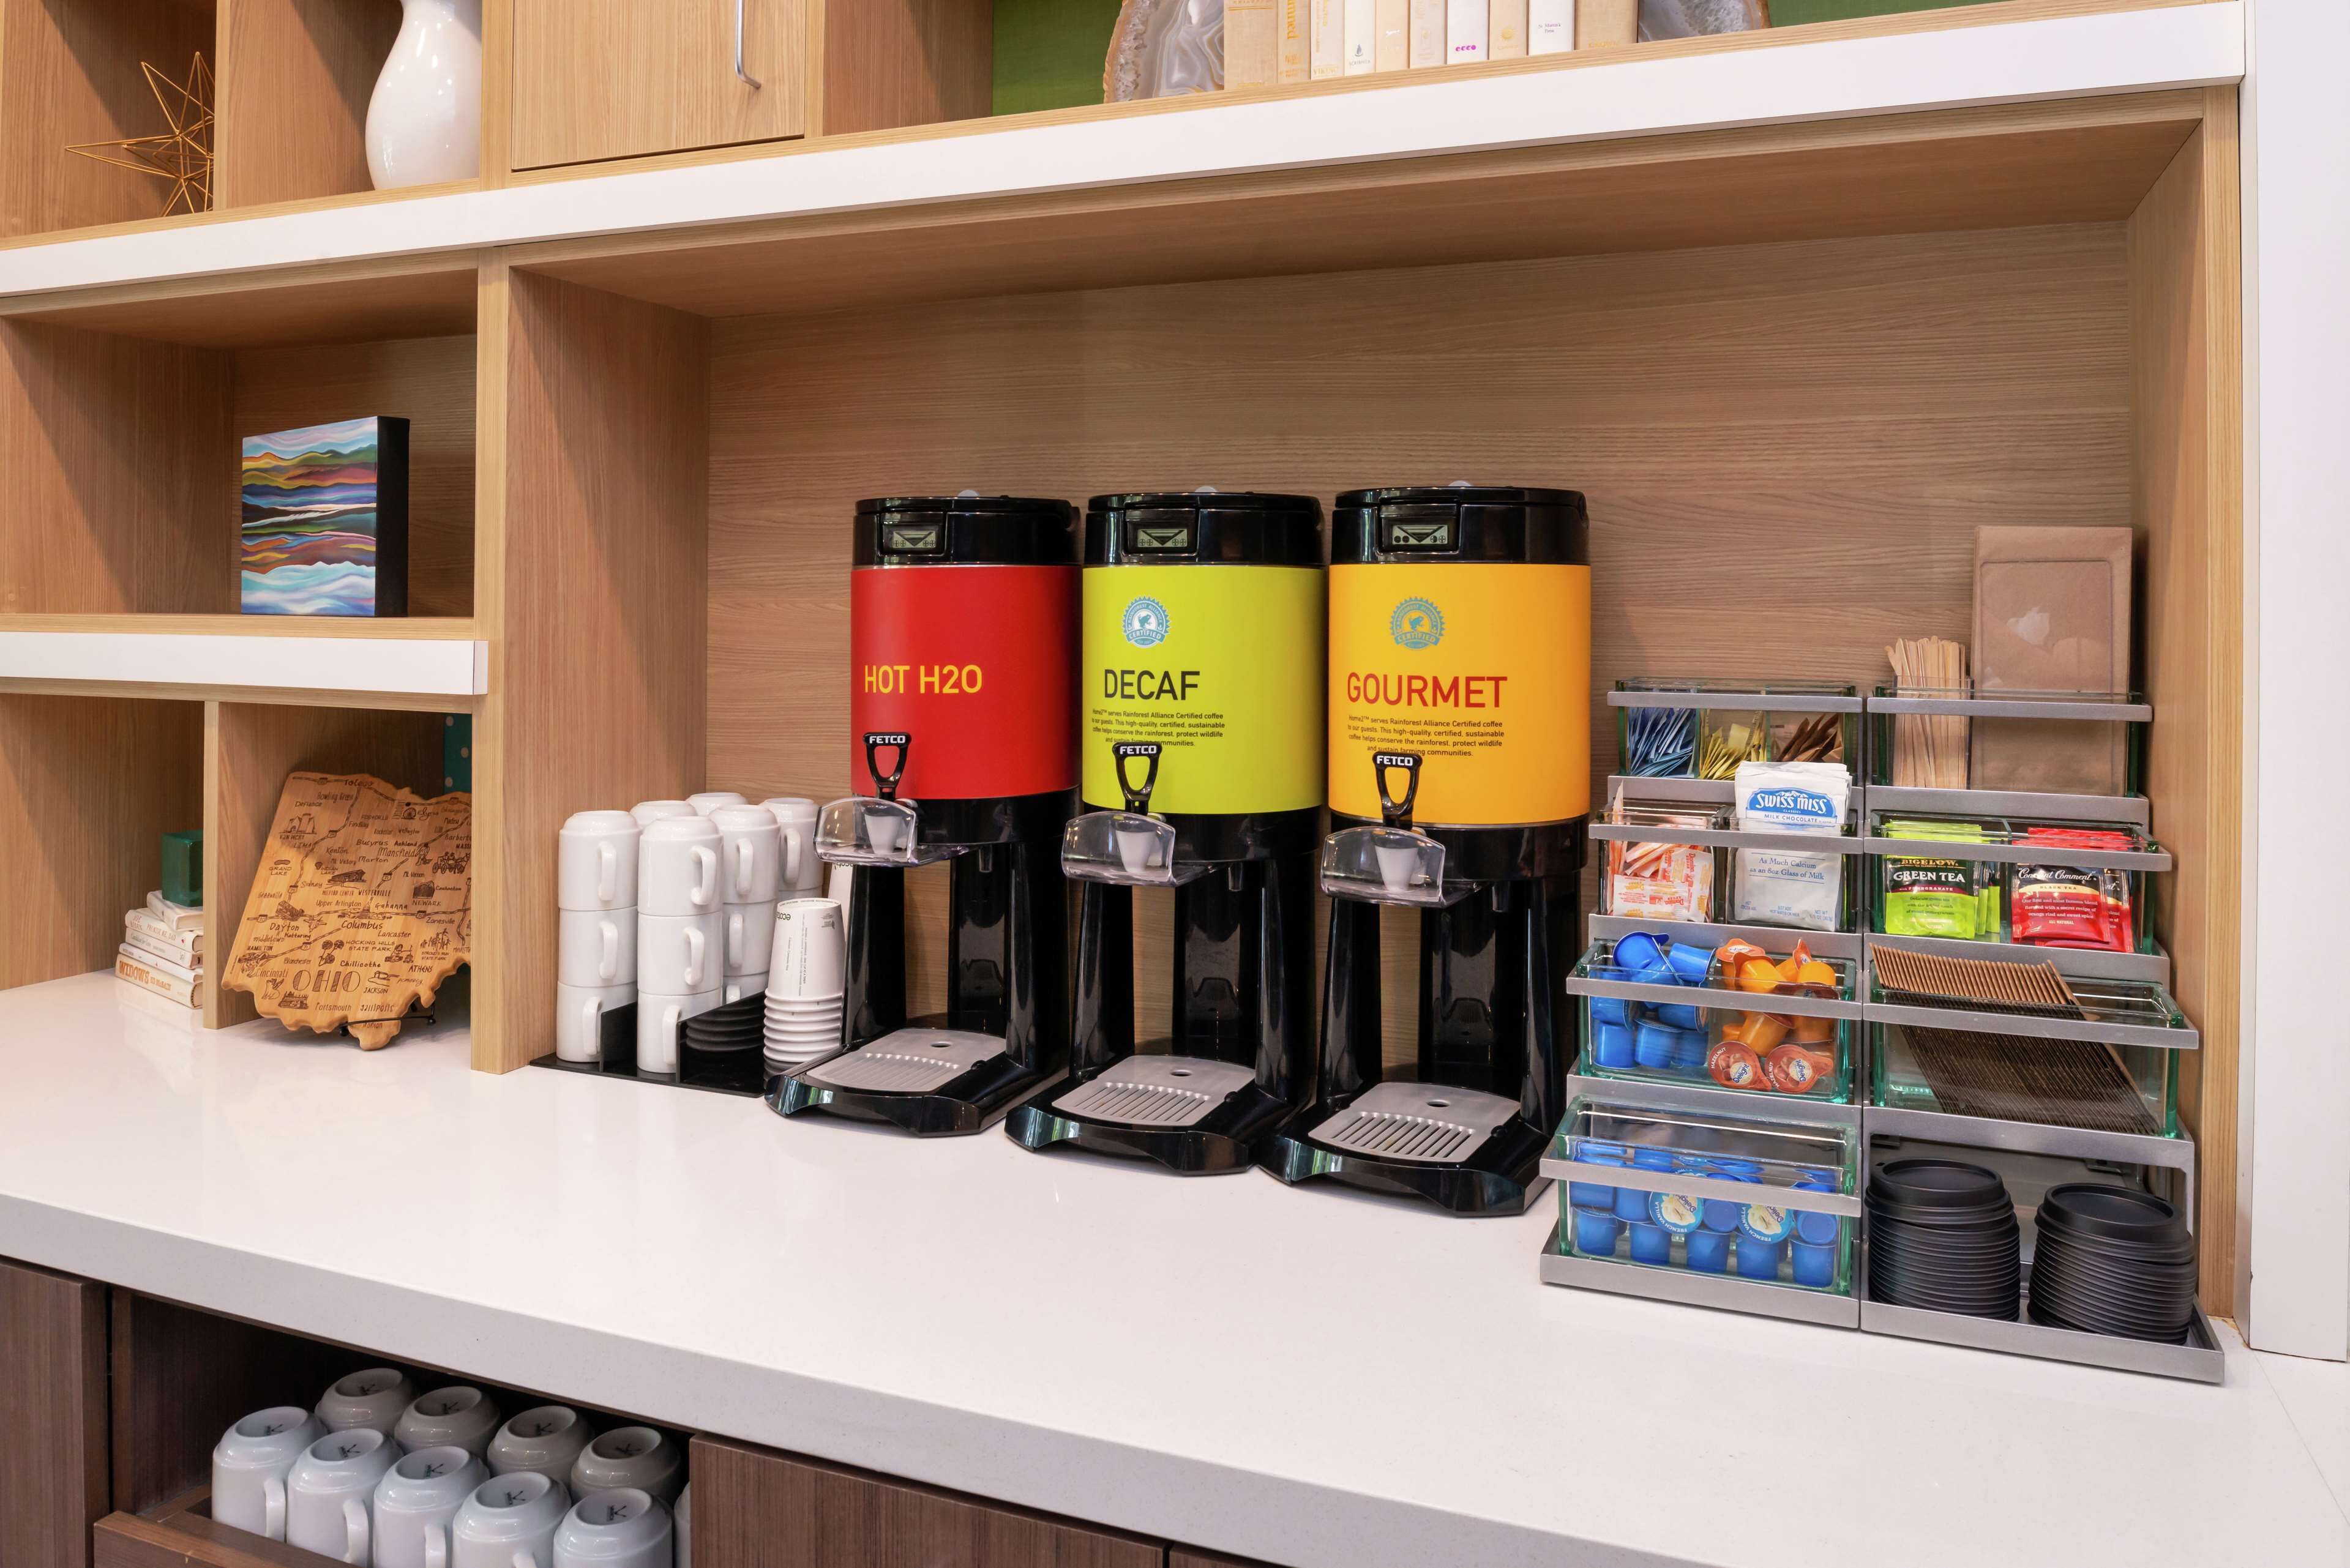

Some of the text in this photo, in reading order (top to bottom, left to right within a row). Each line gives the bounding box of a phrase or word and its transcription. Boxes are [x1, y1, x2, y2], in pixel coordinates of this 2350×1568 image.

[1129, 630, 1161, 640] CERTIFIED
[1398, 632, 1435, 642] CERTIFIED
[865, 665, 982, 693] HOT H2O
[1104, 669, 1200, 700] DECAF
[1347, 672, 1508, 708] GOURMET
[869, 735, 906, 744] FETCO
[1120, 744, 1157, 755] FETCO
[1377, 755, 1413, 766] FETCO
[377, 847, 416, 857] Mansfield
[1769, 857, 1789, 866] Much
[1791, 860, 1817, 869] Calcium
[1781, 868, 1798, 877] Glass
[1808, 872, 1824, 880] Milk
[1893, 871, 1966, 883] GREEN TEA
[301, 880, 323, 889] Sidney
[375, 900, 408, 909] Gahanna
[269, 922, 299, 932] Dayton
[341, 920, 384, 930] Columbus
[284, 932, 311, 941] Kettering
[119, 960, 150, 985] WIDOWS
[256, 968, 289, 978] Cincinnati
[293, 969, 361, 992] OHIO
[315, 1002, 352, 1012] Portsmouth
[1711, 1047, 1726, 1069] HAZELNUT
[1733, 1064, 1751, 1083] Delight
[1795, 1059, 1806, 1082] Delight
[1655, 1201, 1688, 1233] FRENCH VANILLA
[1742, 1207, 1772, 1242] FRENCH VANILLA
